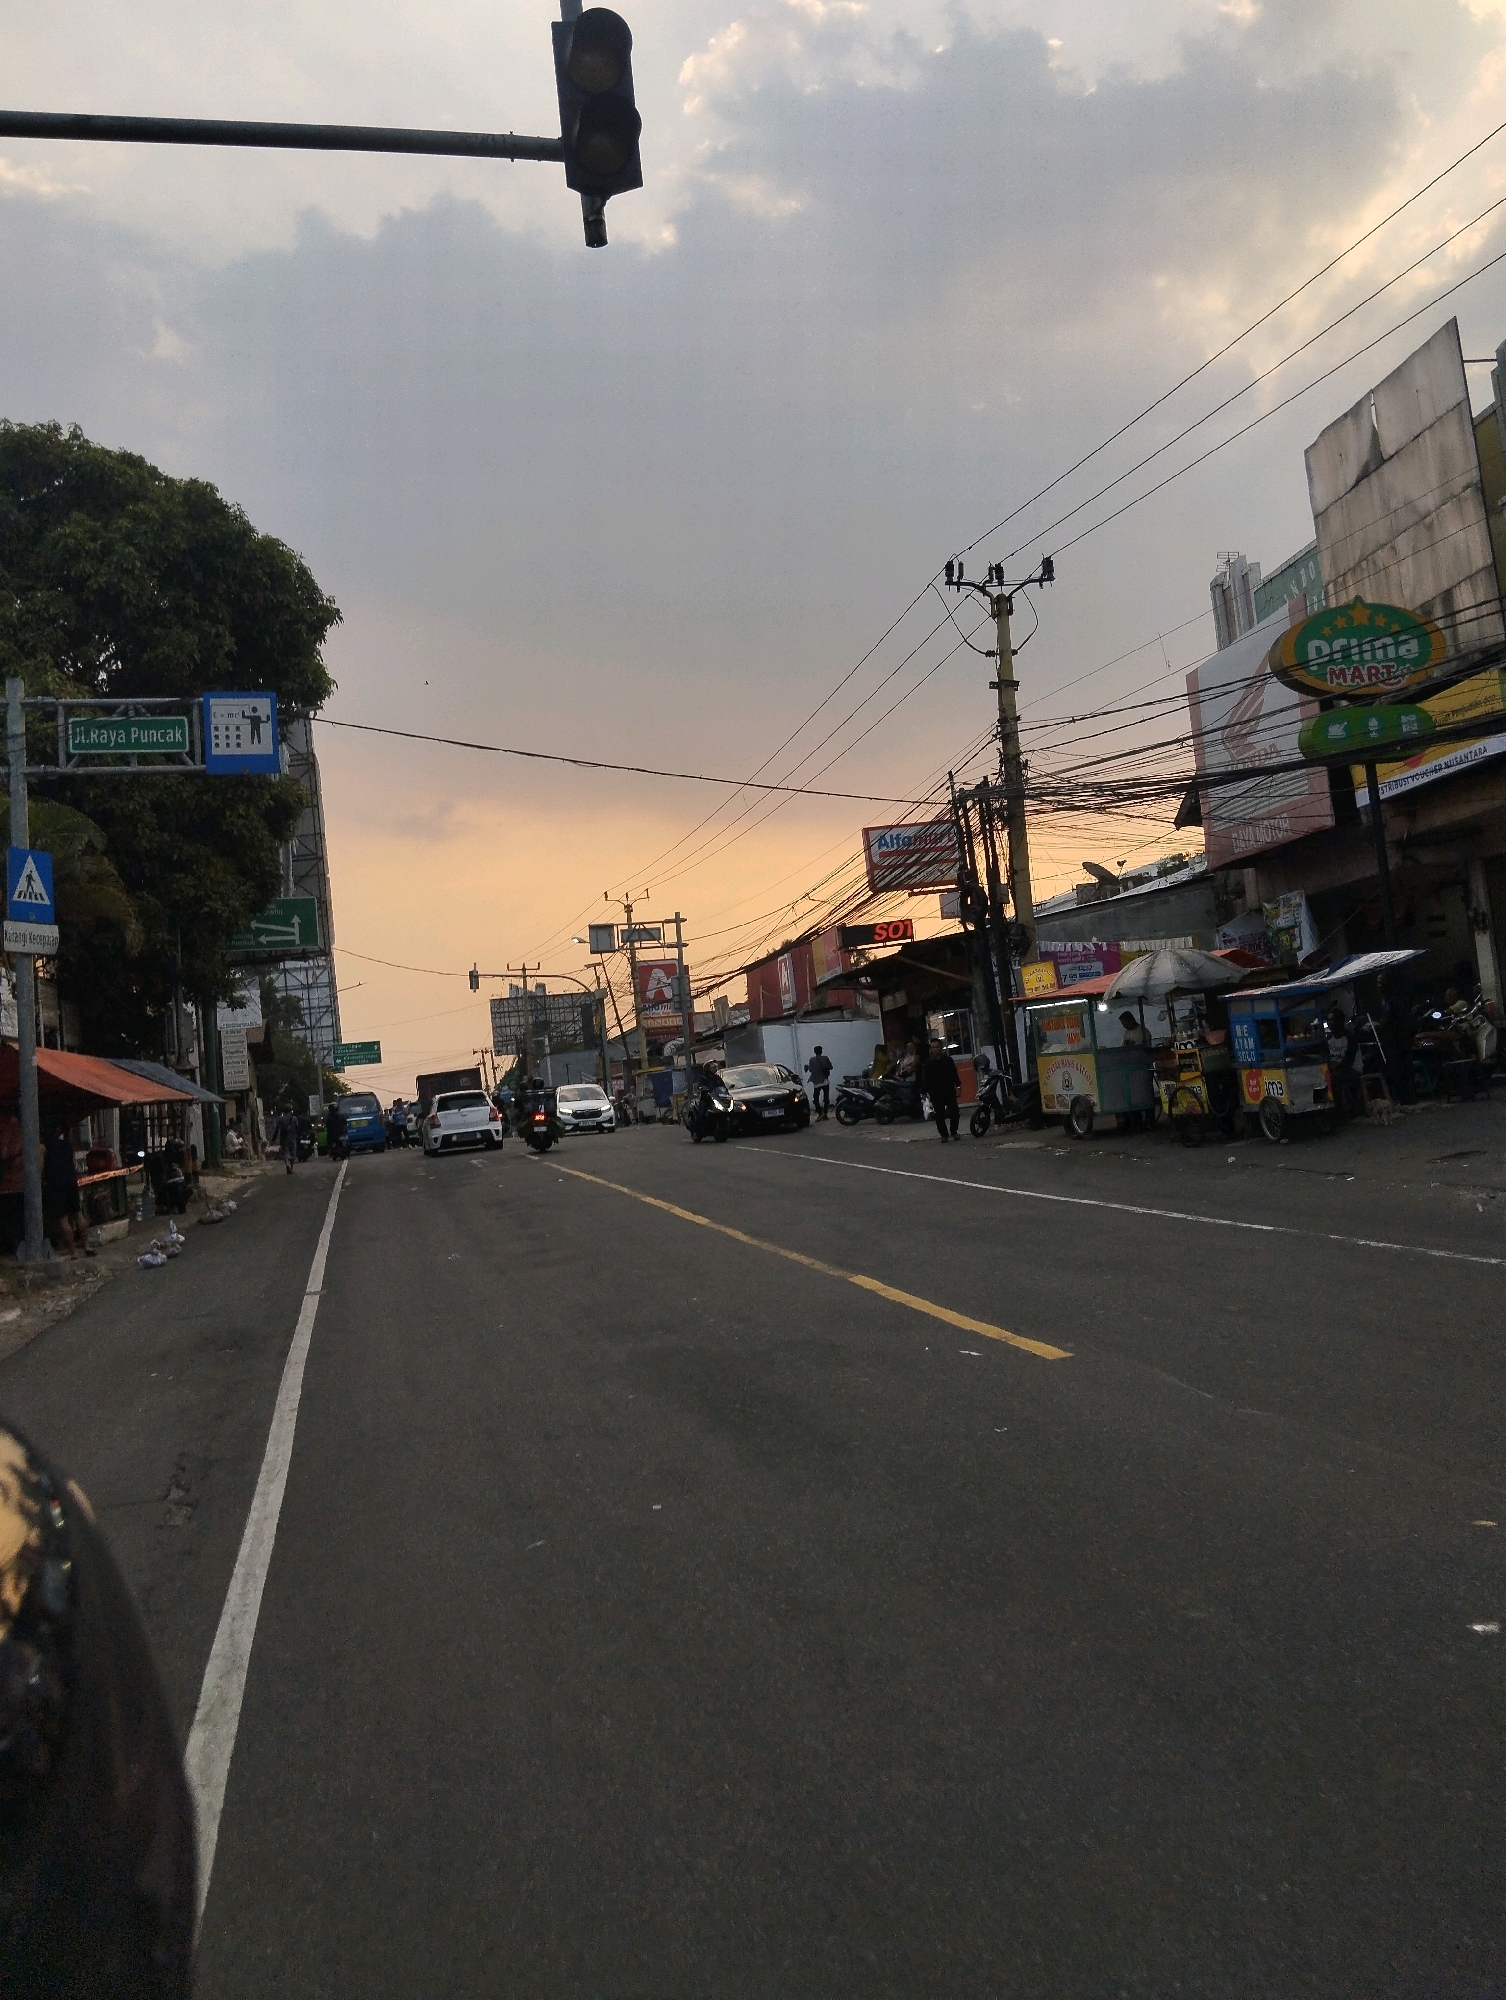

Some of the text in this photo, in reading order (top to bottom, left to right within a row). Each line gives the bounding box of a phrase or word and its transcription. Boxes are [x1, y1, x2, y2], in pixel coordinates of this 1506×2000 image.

[1307, 635, 1419, 671] prima
[1328, 663, 1396, 686] MART
[75, 726, 183, 747] Jl.Raya Puncak
[1378, 746, 1488, 796] STRIBUSI VOUCHER NUSANTARA
[1235, 1038, 1255, 1050] AYAM
[1238, 1051, 1256, 1062] SOLO
